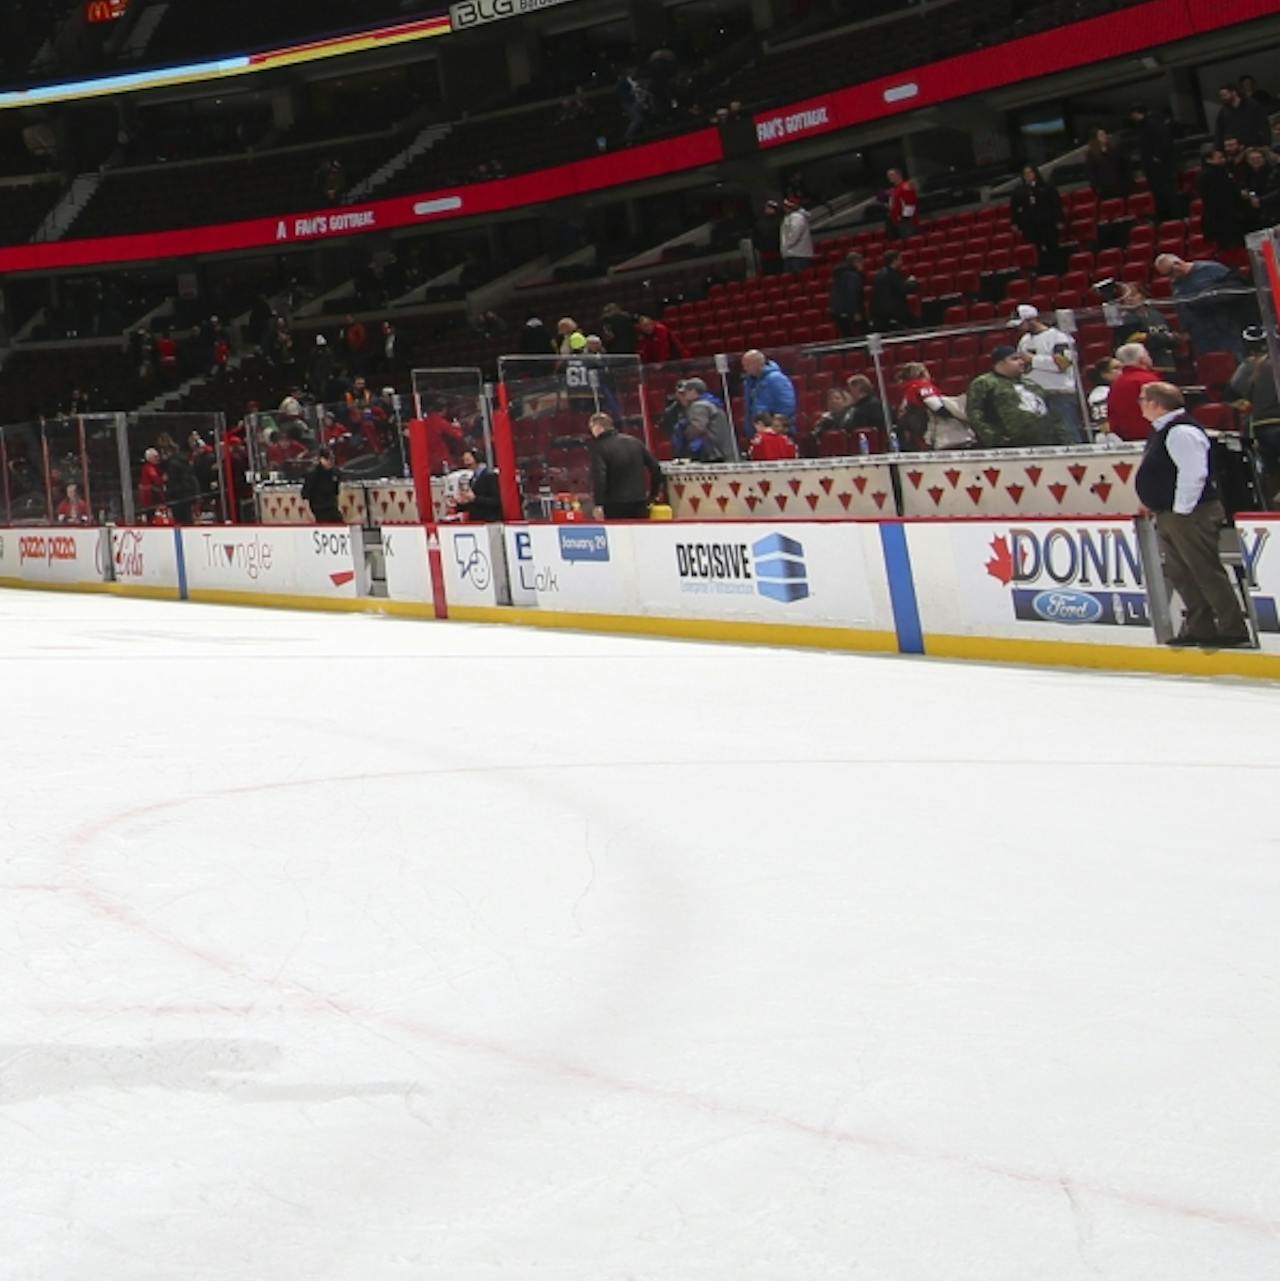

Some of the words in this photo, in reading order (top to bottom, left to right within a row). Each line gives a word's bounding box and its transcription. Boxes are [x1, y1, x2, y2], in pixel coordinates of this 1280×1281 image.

[276, 221, 287, 240] A
[566, 367, 588, 387] 61
[562, 536, 593, 554] January
[676, 544, 751, 579] DECISIVE
[1046, 593, 1088, 619] Ford
